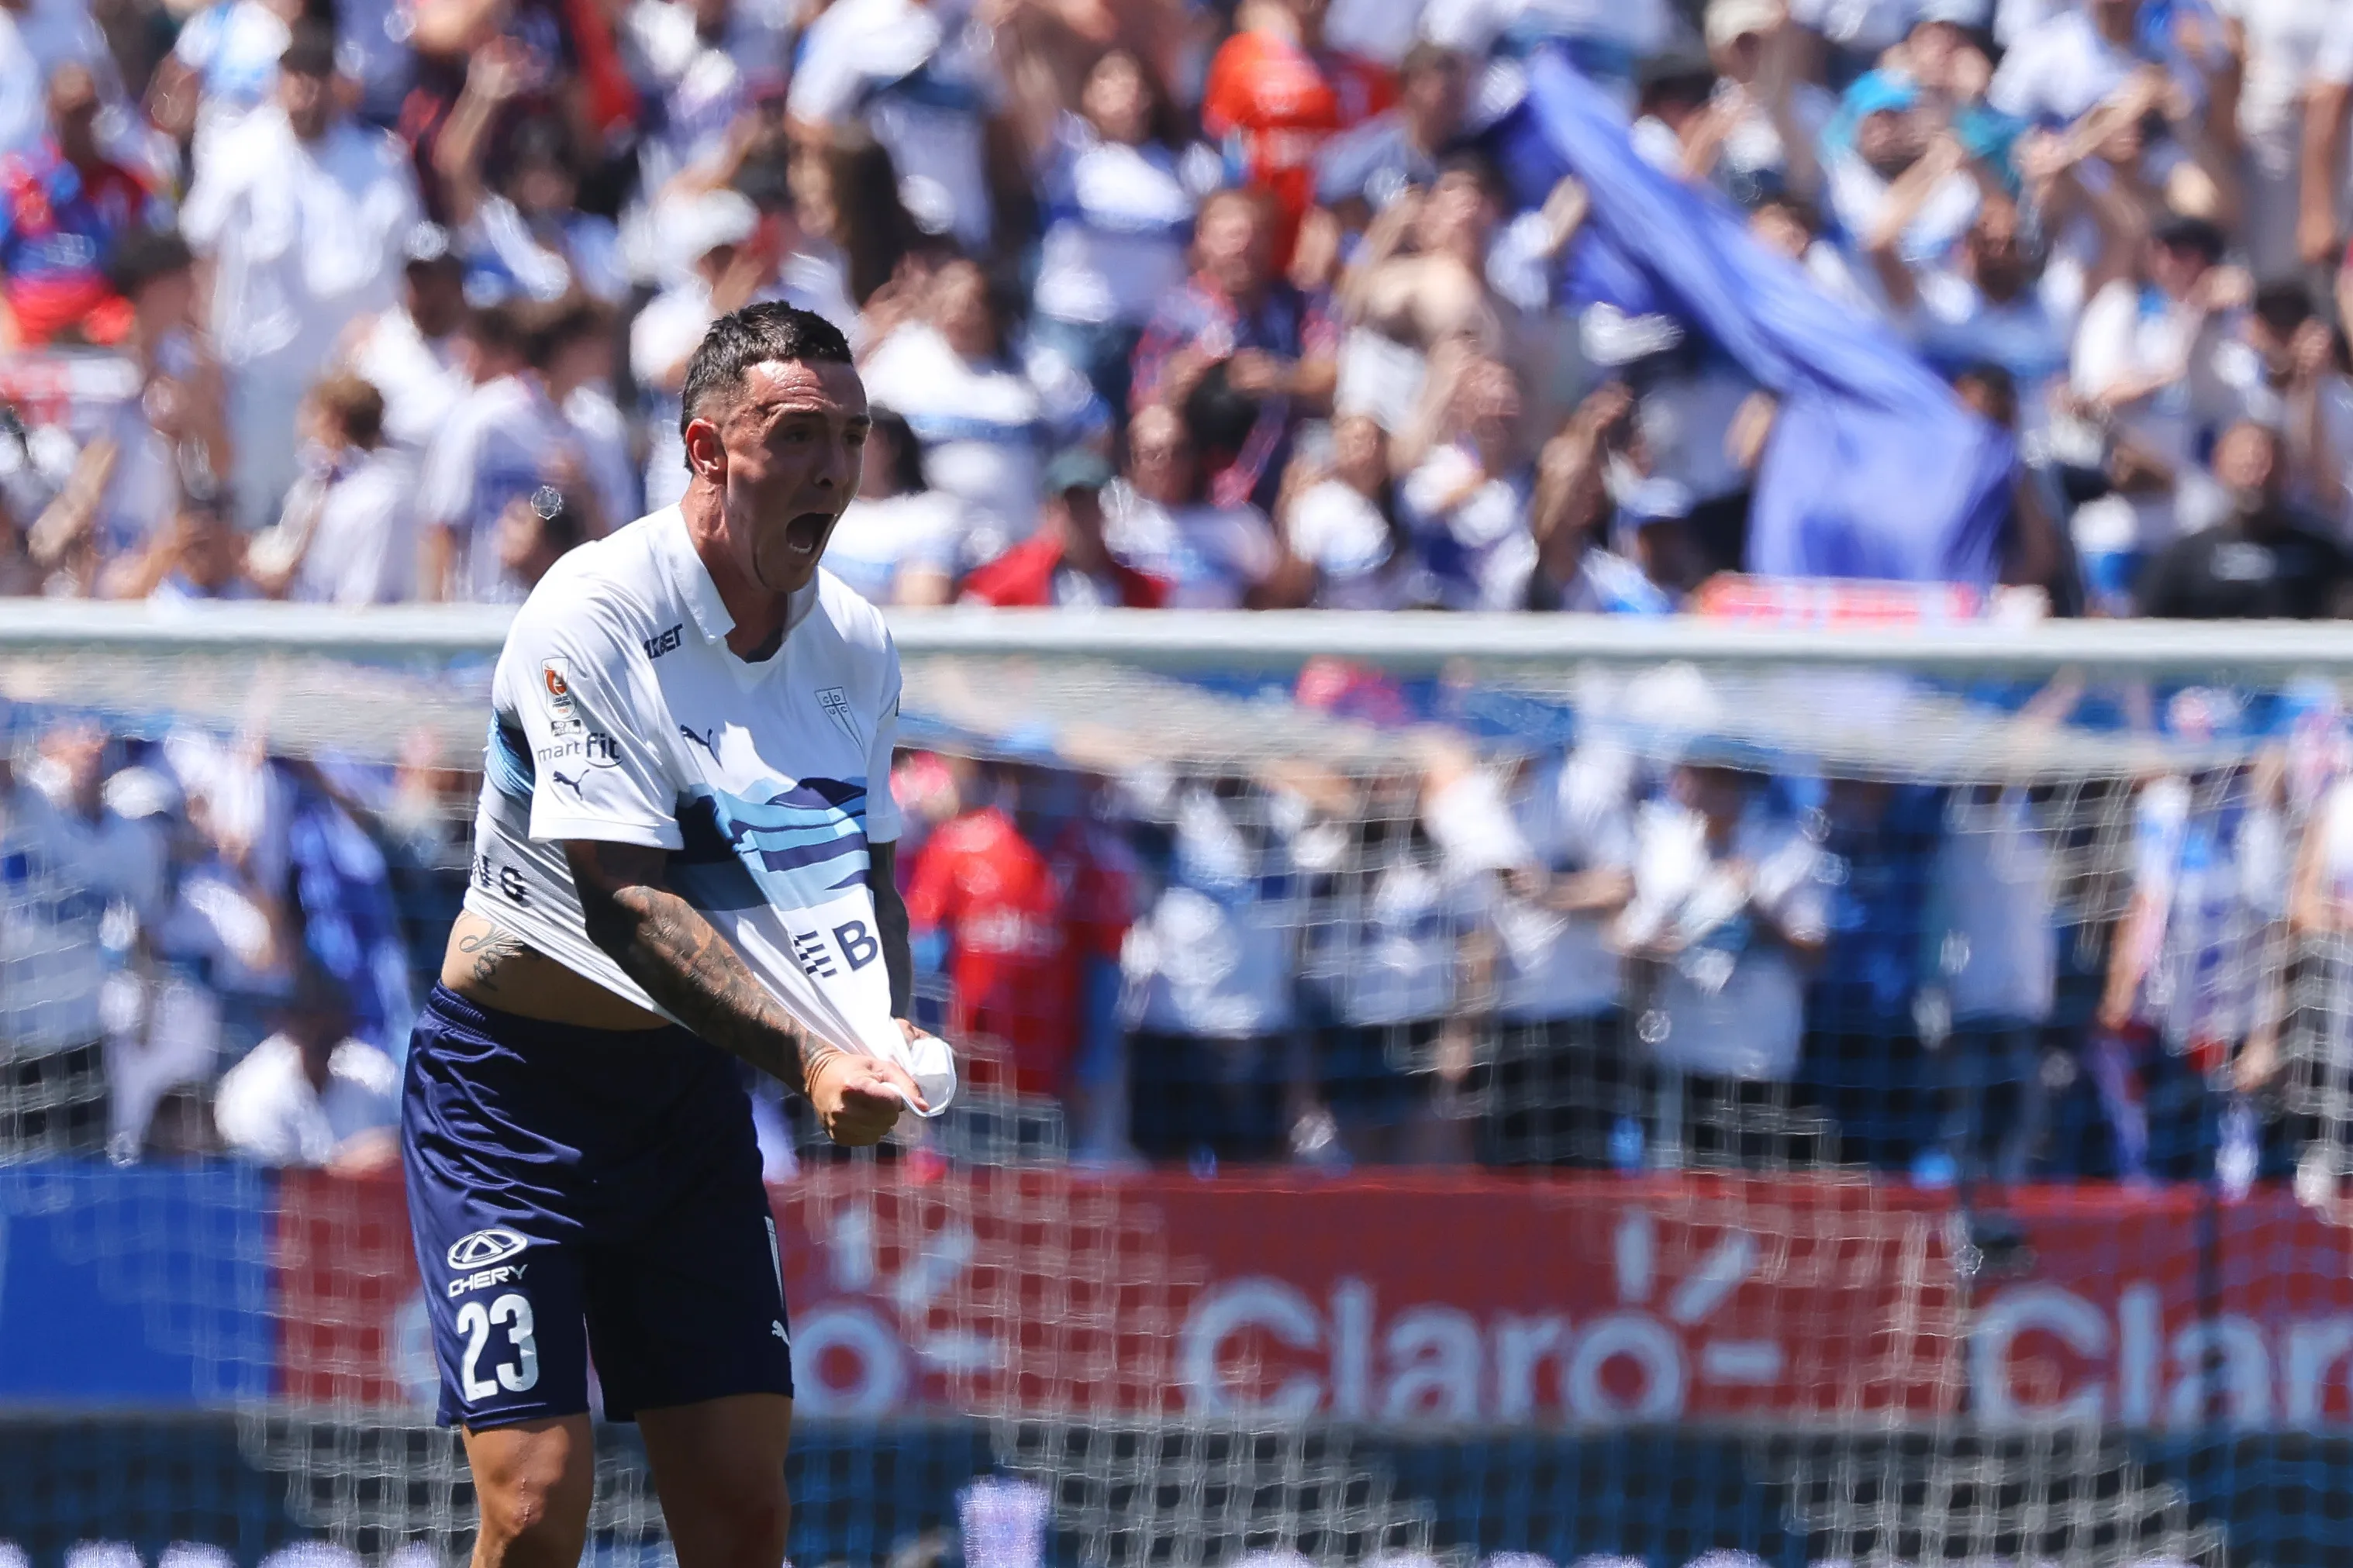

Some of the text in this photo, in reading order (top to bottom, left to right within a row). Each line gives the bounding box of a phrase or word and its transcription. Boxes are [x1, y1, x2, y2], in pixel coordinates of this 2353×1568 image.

[537, 740, 581, 763] mart
[448, 1264, 529, 1297] CHERY
[457, 1293, 538, 1402] 23
[1182, 1275, 1684, 1421] Claro
[1969, 1283, 2353, 1430] Clar
